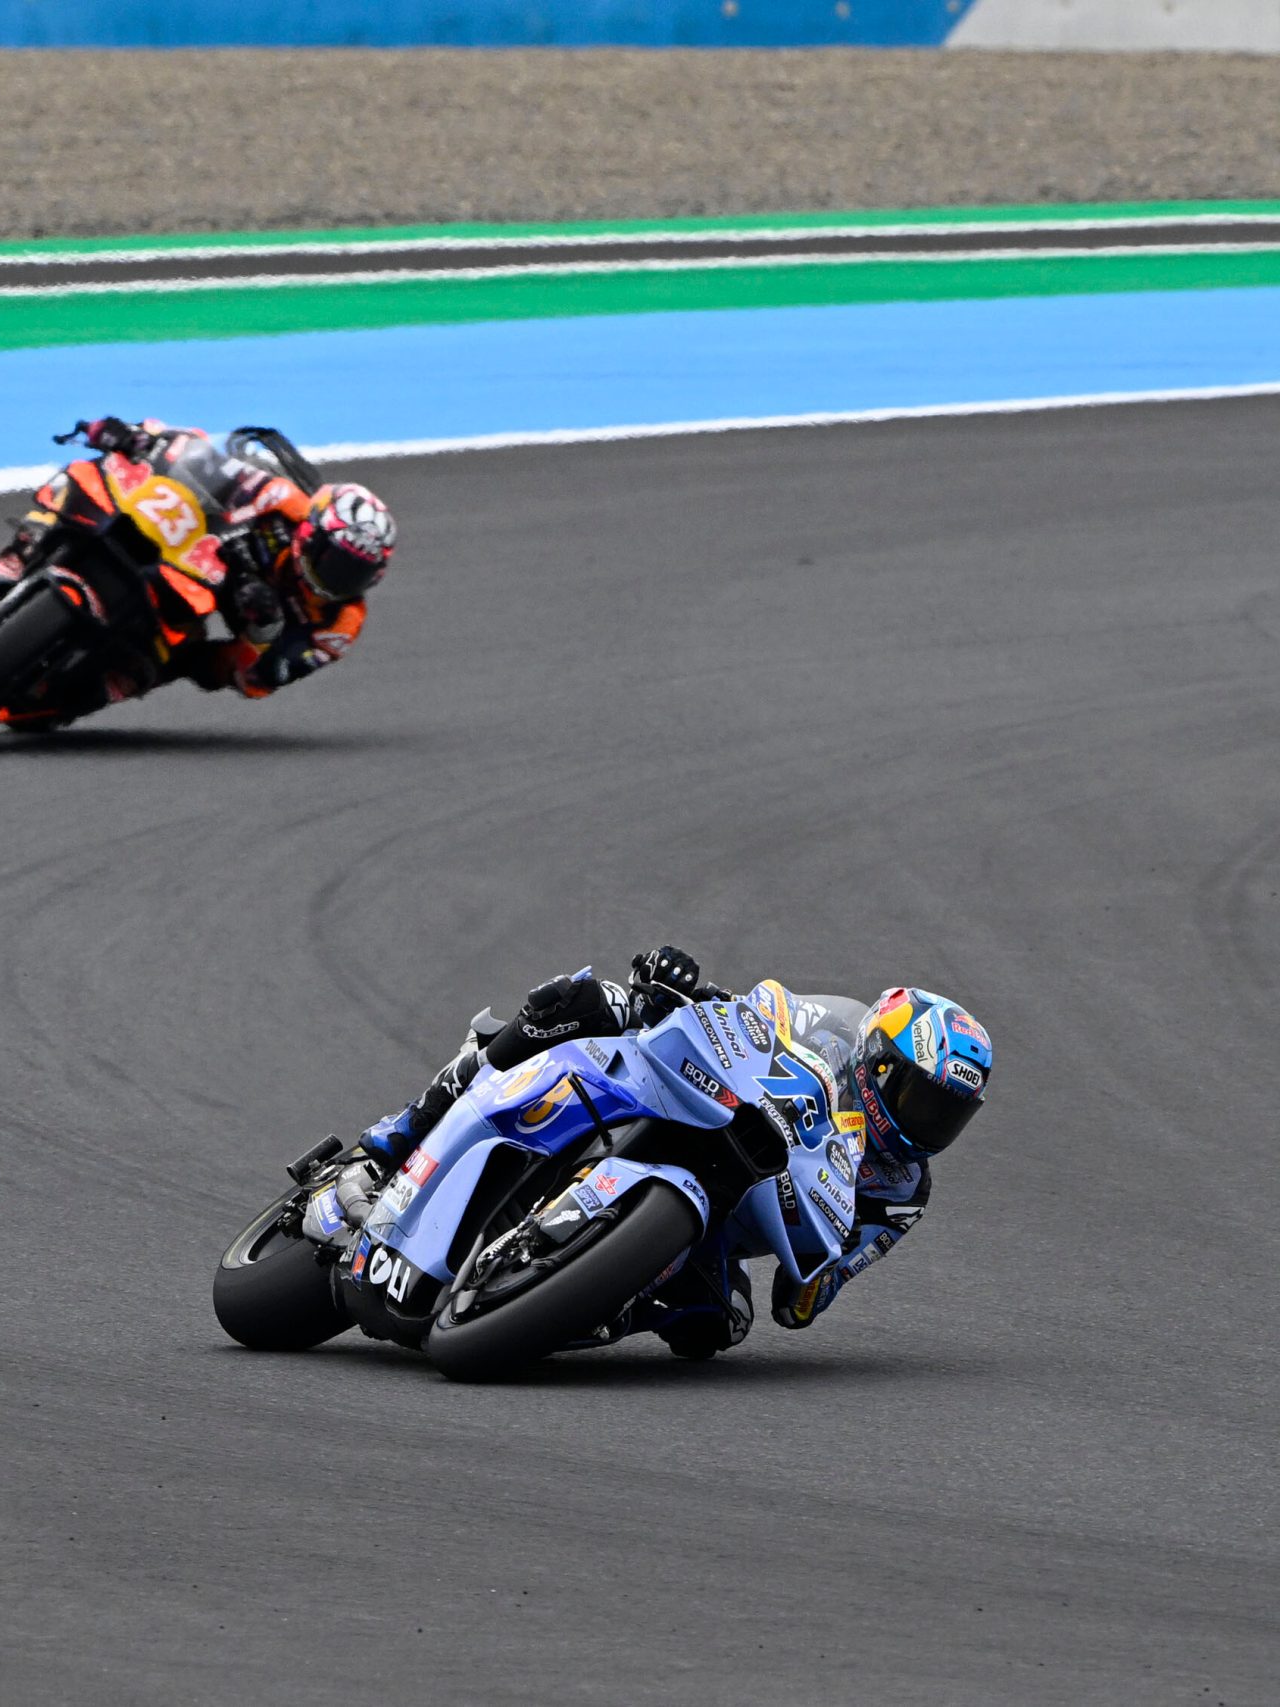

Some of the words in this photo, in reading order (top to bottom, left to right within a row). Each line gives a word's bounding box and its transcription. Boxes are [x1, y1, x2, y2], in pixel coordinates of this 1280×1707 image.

[135, 484, 199, 547] 23
[701, 1016, 719, 1043] GLOW
[715, 1044, 732, 1069] MEN
[740, 1011, 761, 1045] Galicia
[743, 1010, 768, 1046] Estrella
[913, 1021, 929, 1064] verleal
[584, 1039, 610, 1068] DUCATI
[684, 1062, 720, 1093] BOLD
[951, 1063, 980, 1086] SHOEI
[751, 1051, 835, 1153] 73
[780, 1171, 796, 1210] BOLD
[809, 1188, 820, 1203] MS
[818, 1198, 837, 1221] GLOW
[834, 1219, 851, 1239] MEN
